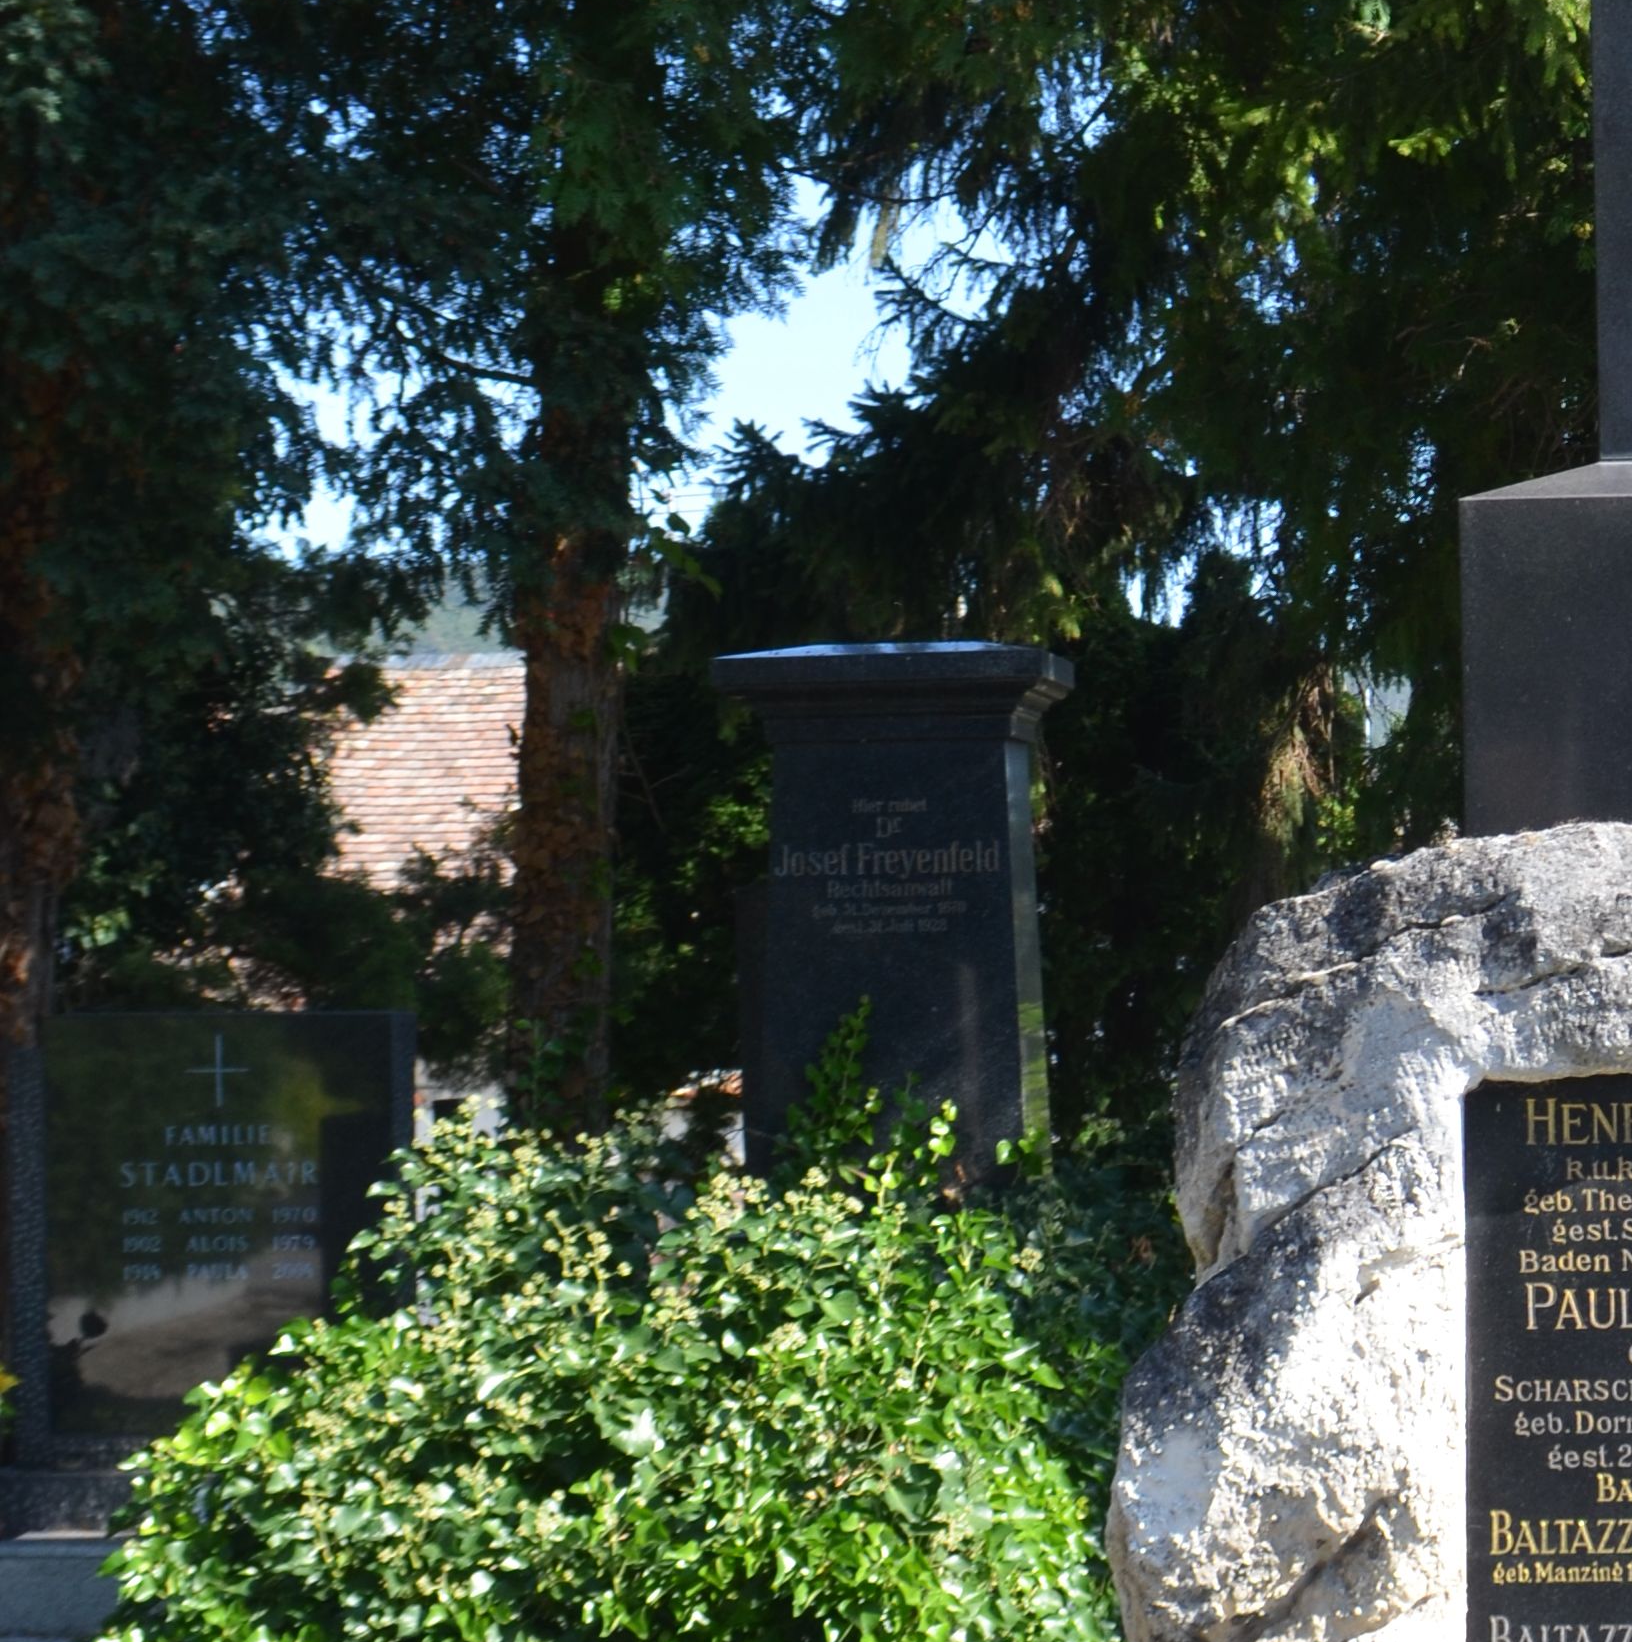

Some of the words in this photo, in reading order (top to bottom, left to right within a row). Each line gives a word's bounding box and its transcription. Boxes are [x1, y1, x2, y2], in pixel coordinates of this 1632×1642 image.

[774, 843, 851, 877] Josef
[857, 840, 1000, 878] Freyenfeld
[164, 1123, 272, 1146] FAMILIE
[1522, 1187, 1578, 1215] geb.
[178, 1206, 254, 1225] ANTON
[185, 1234, 250, 1253] ALOIS
[1518, 1248, 1612, 1274] Baden
[1513, 1410, 1571, 1438] geb.
